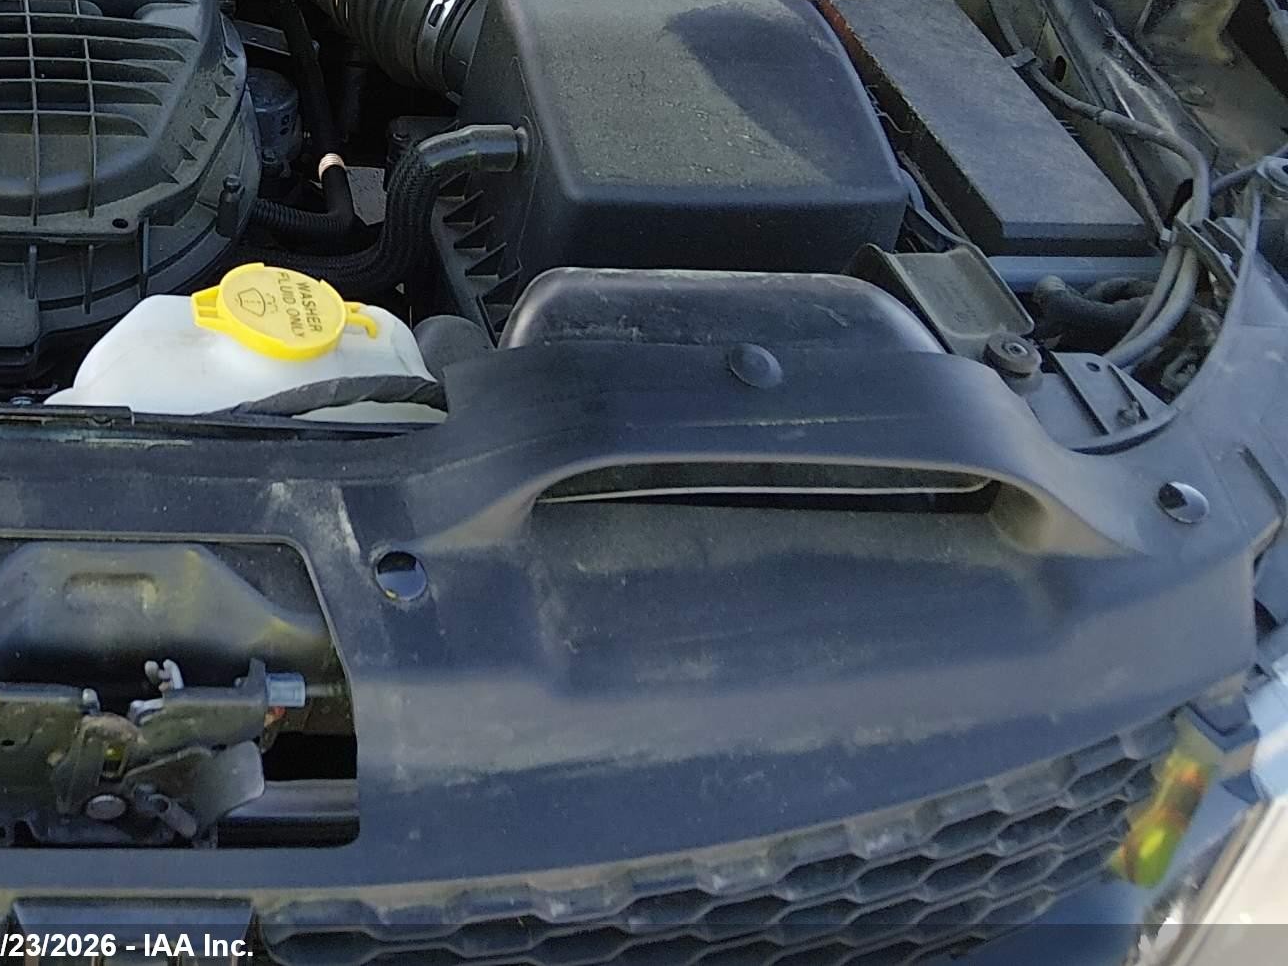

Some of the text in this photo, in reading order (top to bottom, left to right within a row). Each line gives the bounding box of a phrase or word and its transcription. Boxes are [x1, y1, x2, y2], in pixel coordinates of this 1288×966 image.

[277, 271, 305, 338] FLUID ONLY
[296, 282, 323, 332] WASHER
